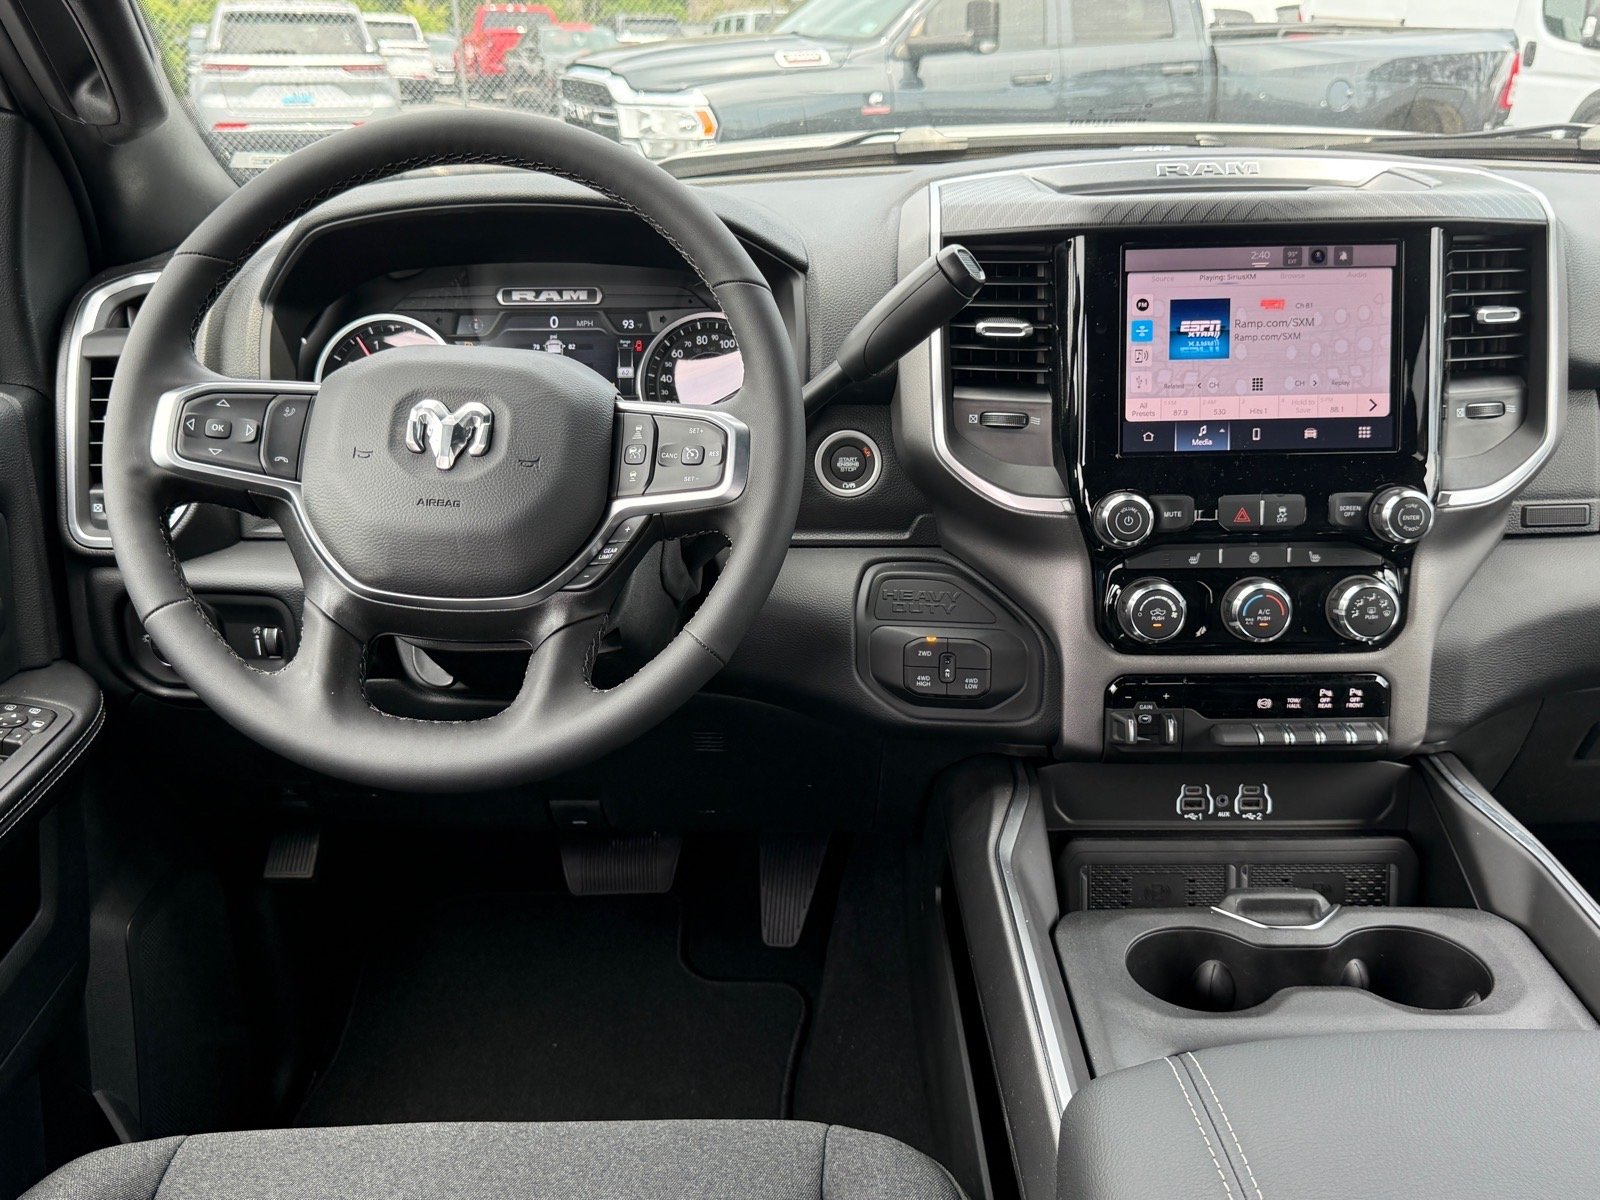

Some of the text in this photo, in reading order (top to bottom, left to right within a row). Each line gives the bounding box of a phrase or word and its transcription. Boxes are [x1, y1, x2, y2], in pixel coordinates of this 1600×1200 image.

[1156, 162, 1260, 177] RAM
[1250, 250, 1271, 260] 2:40
[1199, 274, 1226, 282] Playing:
[511, 290, 588, 301] RAM
[549, 316, 559, 329] 0
[622, 320, 634, 329] 93
[1180, 320, 1221, 332] ESPN
[1234, 318, 1315, 329] Ramp.com/SXM
[696, 335, 708, 345] 80
[1234, 333, 1301, 342] Ramp.com/SXM
[720, 339, 736, 348] 100
[671, 349, 684, 358] 60
[660, 374, 673, 383] 40
[211, 423, 224, 432] OK
[1191, 438, 1213, 446] Media
[661, 451, 678, 459] CANC
[416, 498, 461, 508] AIRBAG
[1120, 506, 1139, 514] VOLUME
[1163, 510, 1182, 518] MUTE
[882, 589, 961, 603] HEAVY
[891, 602, 957, 615] DUTY
[1257, 608, 1271, 616] A/C
